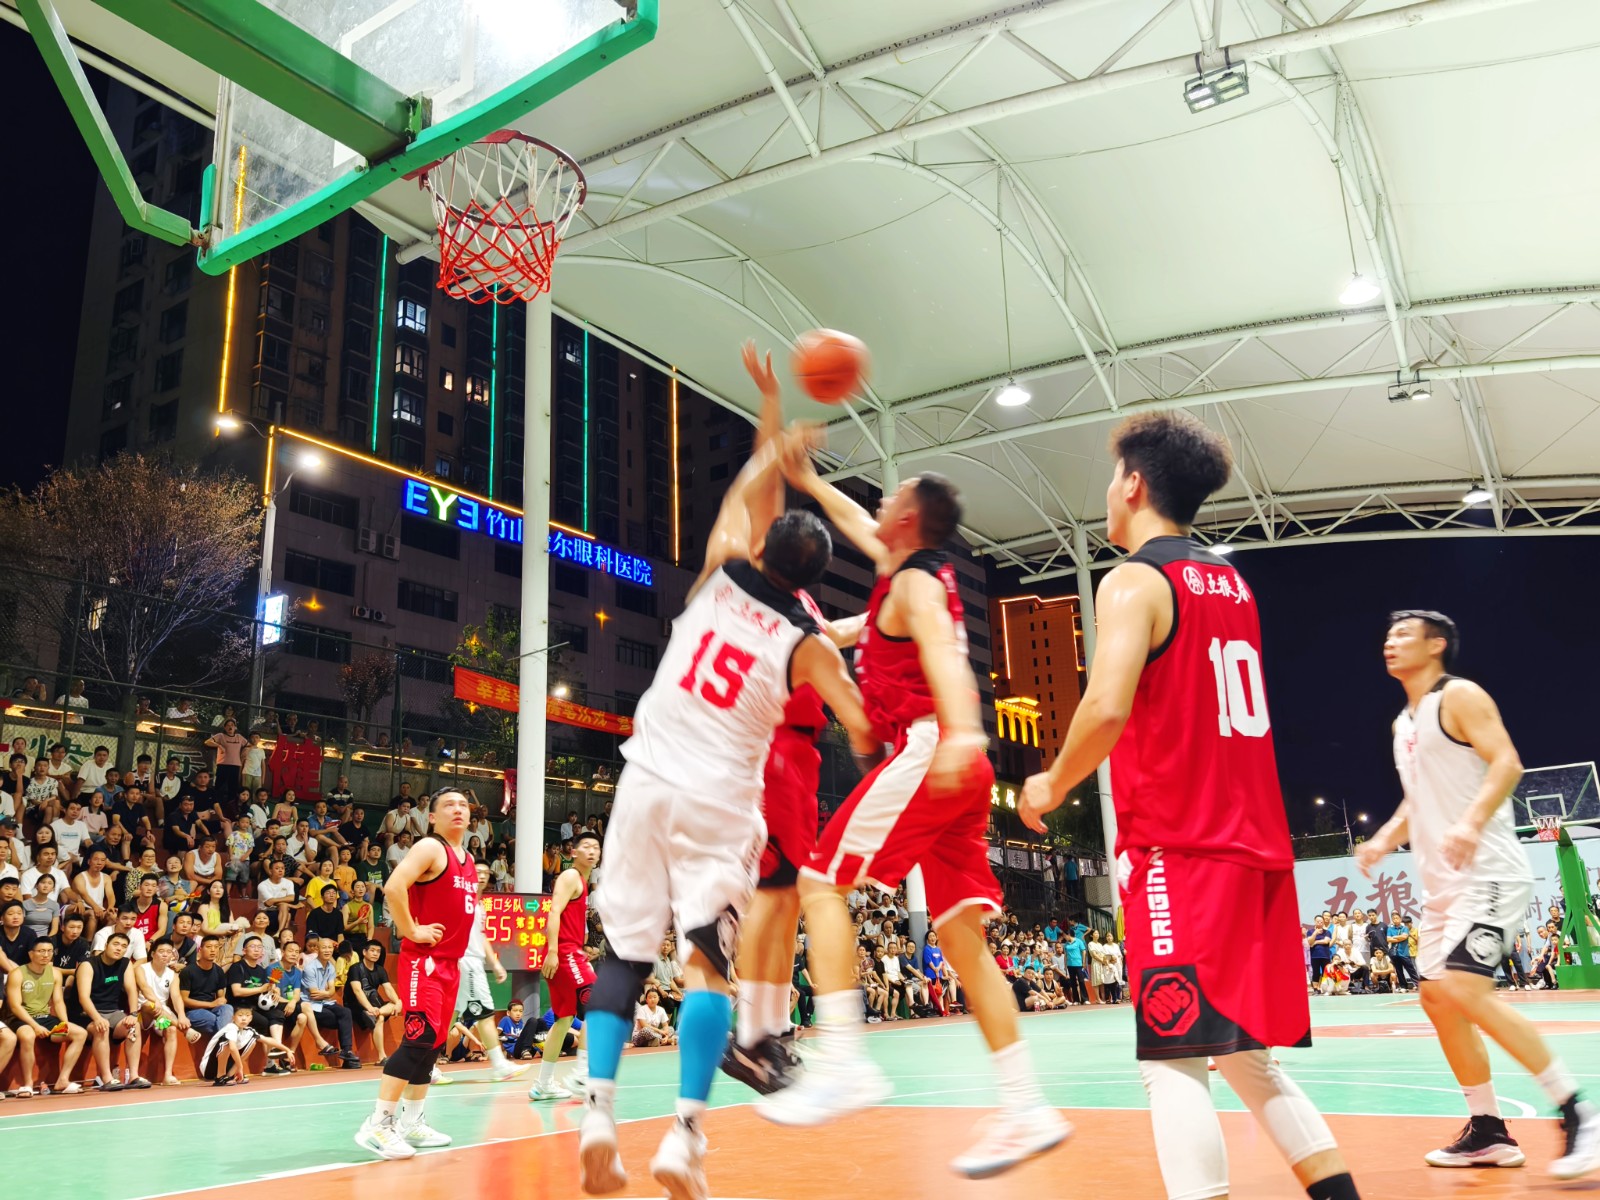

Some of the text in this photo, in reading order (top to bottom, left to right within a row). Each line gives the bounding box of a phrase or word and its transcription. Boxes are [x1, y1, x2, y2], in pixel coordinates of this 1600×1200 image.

[485, 507, 652, 586] 竹山尔眼科医院
[678, 630, 757, 709] 15
[1208, 637, 1271, 737] 10
[464, 894, 474, 914] 6
[486, 916, 512, 941] 55
[164, 979, 170, 988] 3
